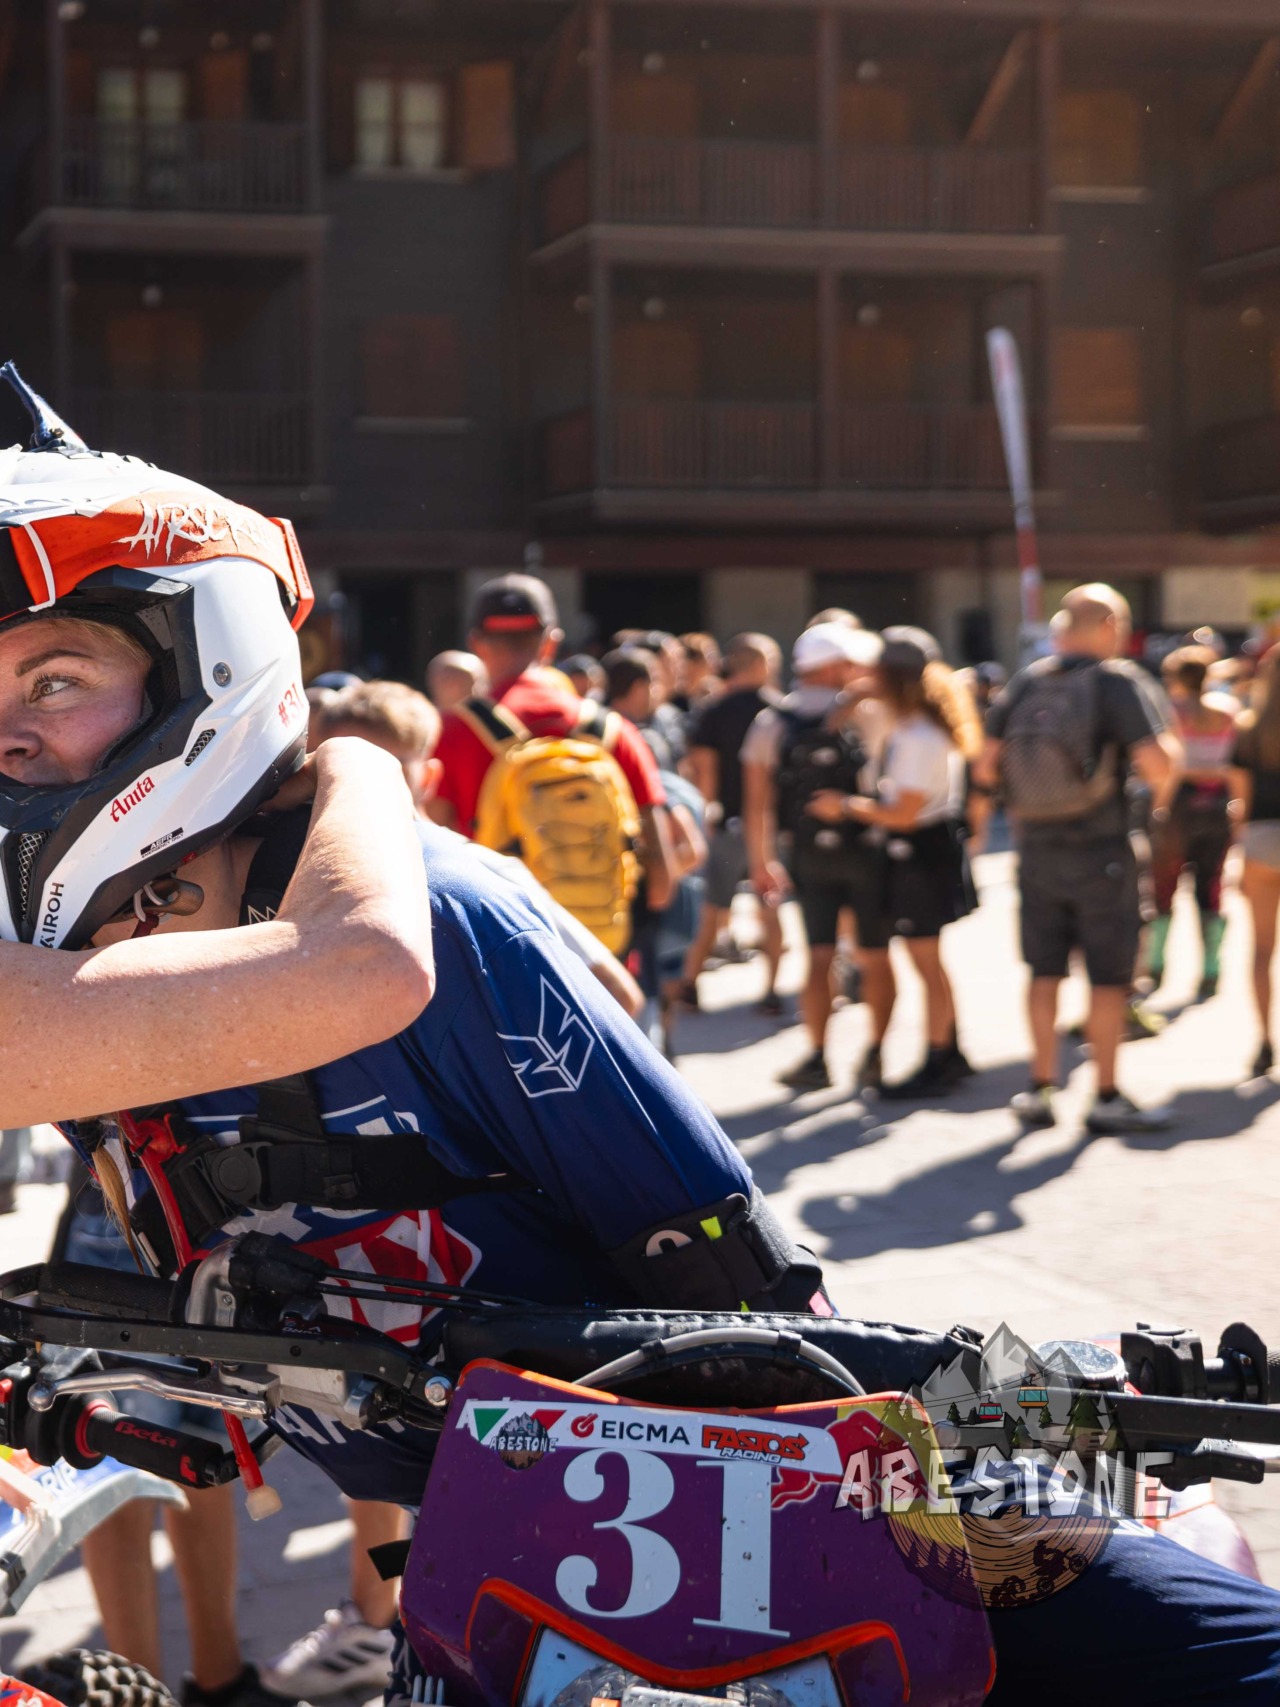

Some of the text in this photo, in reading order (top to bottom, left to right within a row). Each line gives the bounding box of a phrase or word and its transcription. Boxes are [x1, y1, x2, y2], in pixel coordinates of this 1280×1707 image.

[110, 776, 156, 823] Anita
[39, 882, 64, 949] AIROH
[115, 1421, 177, 1448] Beta
[489, 1435, 559, 1452] ABESTONE
[601, 1419, 809, 1460] EICMA FASTOS
[720, 1447, 782, 1464] RACING
[556, 1448, 790, 1638] 31
